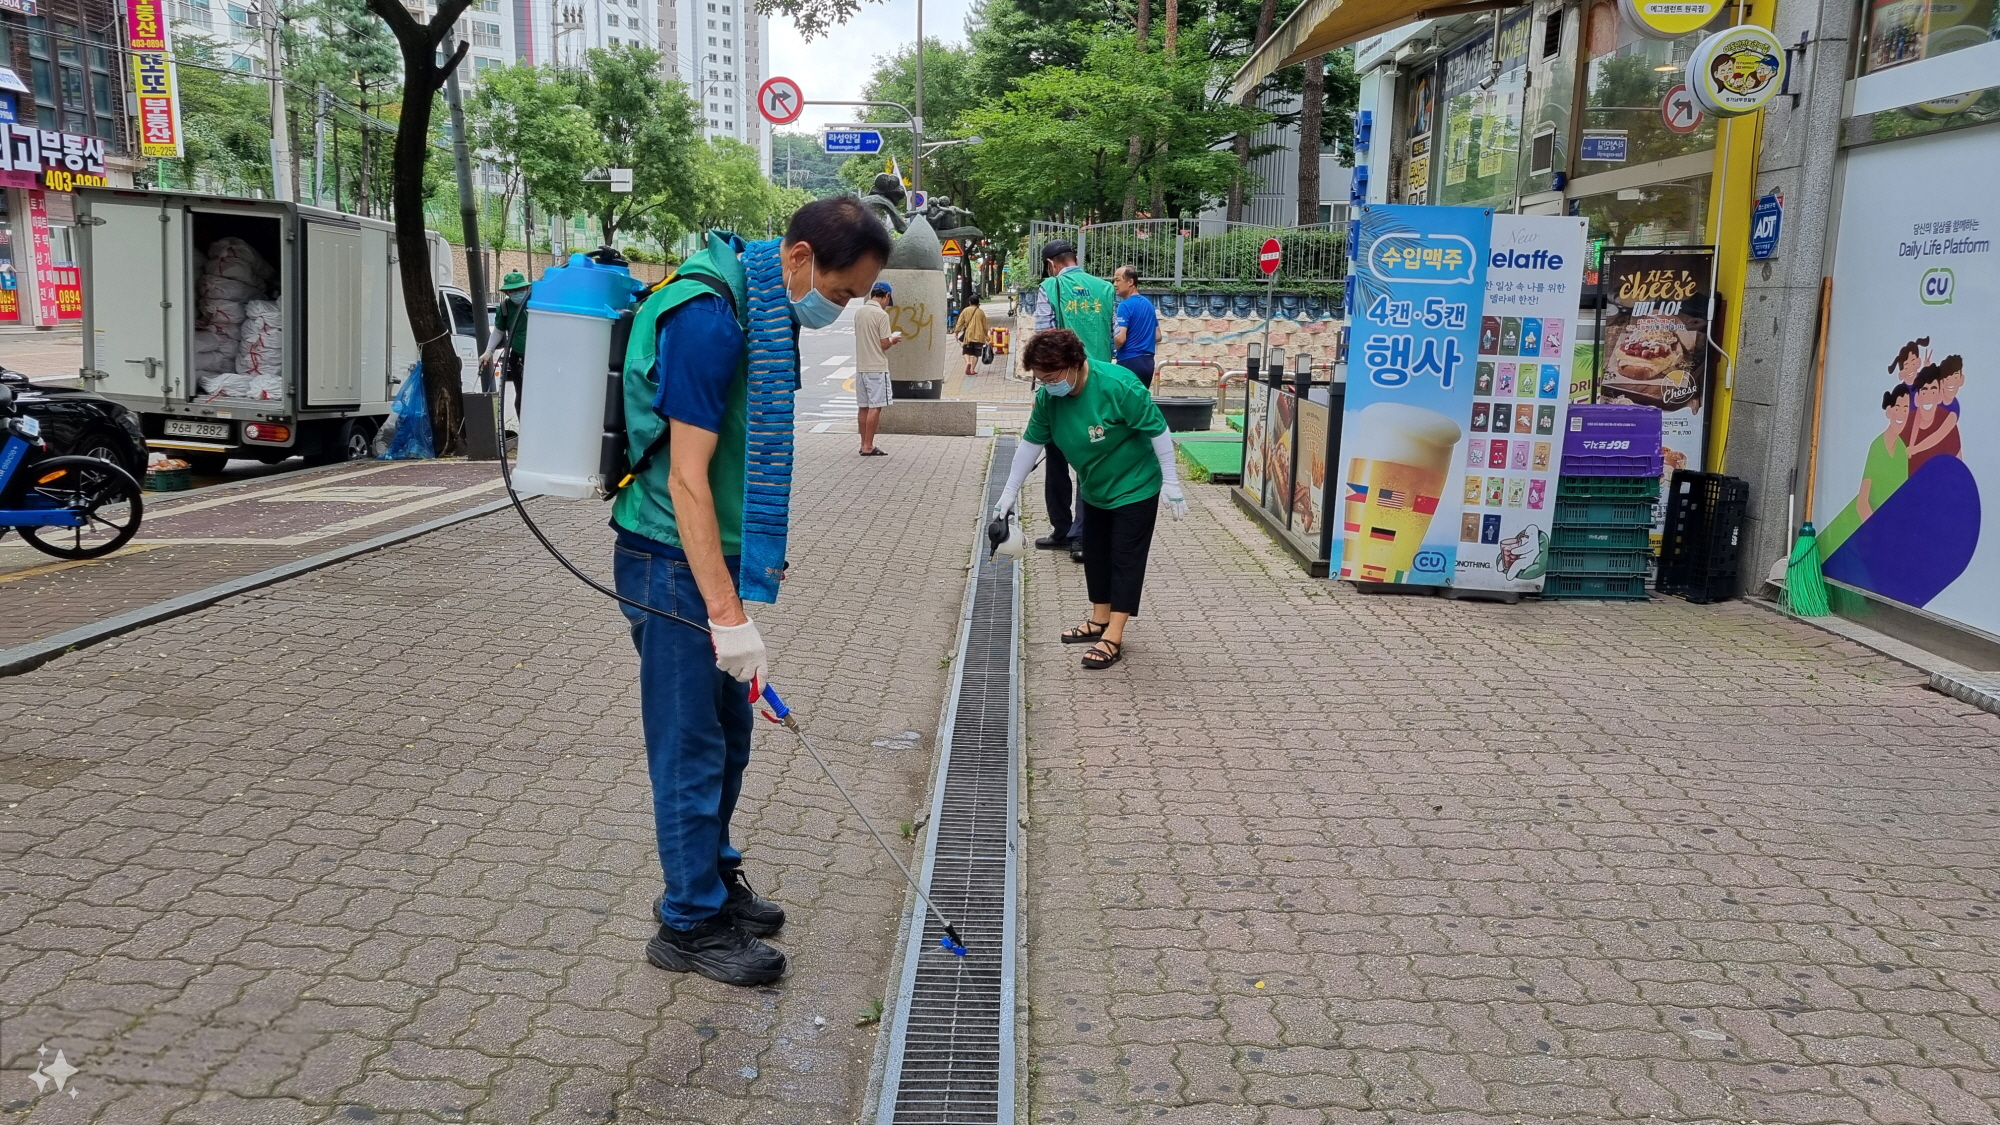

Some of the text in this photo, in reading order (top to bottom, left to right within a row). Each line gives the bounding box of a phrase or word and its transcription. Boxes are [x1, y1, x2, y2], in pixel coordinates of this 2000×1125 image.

[1685, 5, 1704, 13] 원곡점
[131, 39, 164, 48] 403-0894
[145, 98, 172, 143] 부동산
[828, 134, 860, 144] 라성안길
[143, 146, 177, 157] 402-2255
[1754, 216, 1776, 240] ADT
[1913, 218, 1980, 236] 당신의 일상을 함께하는
[1502, 228, 1537, 247] New
[1899, 236, 1990, 260] Daily Life Platform
[36, 252, 51, 266] 상가
[1382, 247, 1463, 270] 수입맥주
[1488, 248, 1563, 270] elaffe
[1645, 270, 1676, 283] 치즈
[1072, 288, 1090, 296] SMU
[1496, 281, 1513, 292] 일상
[1516, 282, 1524, 292] 속
[1528, 282, 1544, 292] 나를
[1548, 283, 1566, 293] 위한
[1619, 271, 1697, 301] cheese
[1926, 278, 1948, 296] CU
[40, 288, 55, 300] 전세
[1490, 294, 1539, 305] 델라페 한잔!
[42, 305, 56, 318] 월세
[1064, 299, 1102, 315] 새마을
[1364, 334, 1464, 389] 행사
[1663, 385, 1698, 404] Cheese
[196, 425, 222, 436] 2882
[1583, 440, 1630, 450] BGF로지스
[1419, 556, 1440, 568] CU
